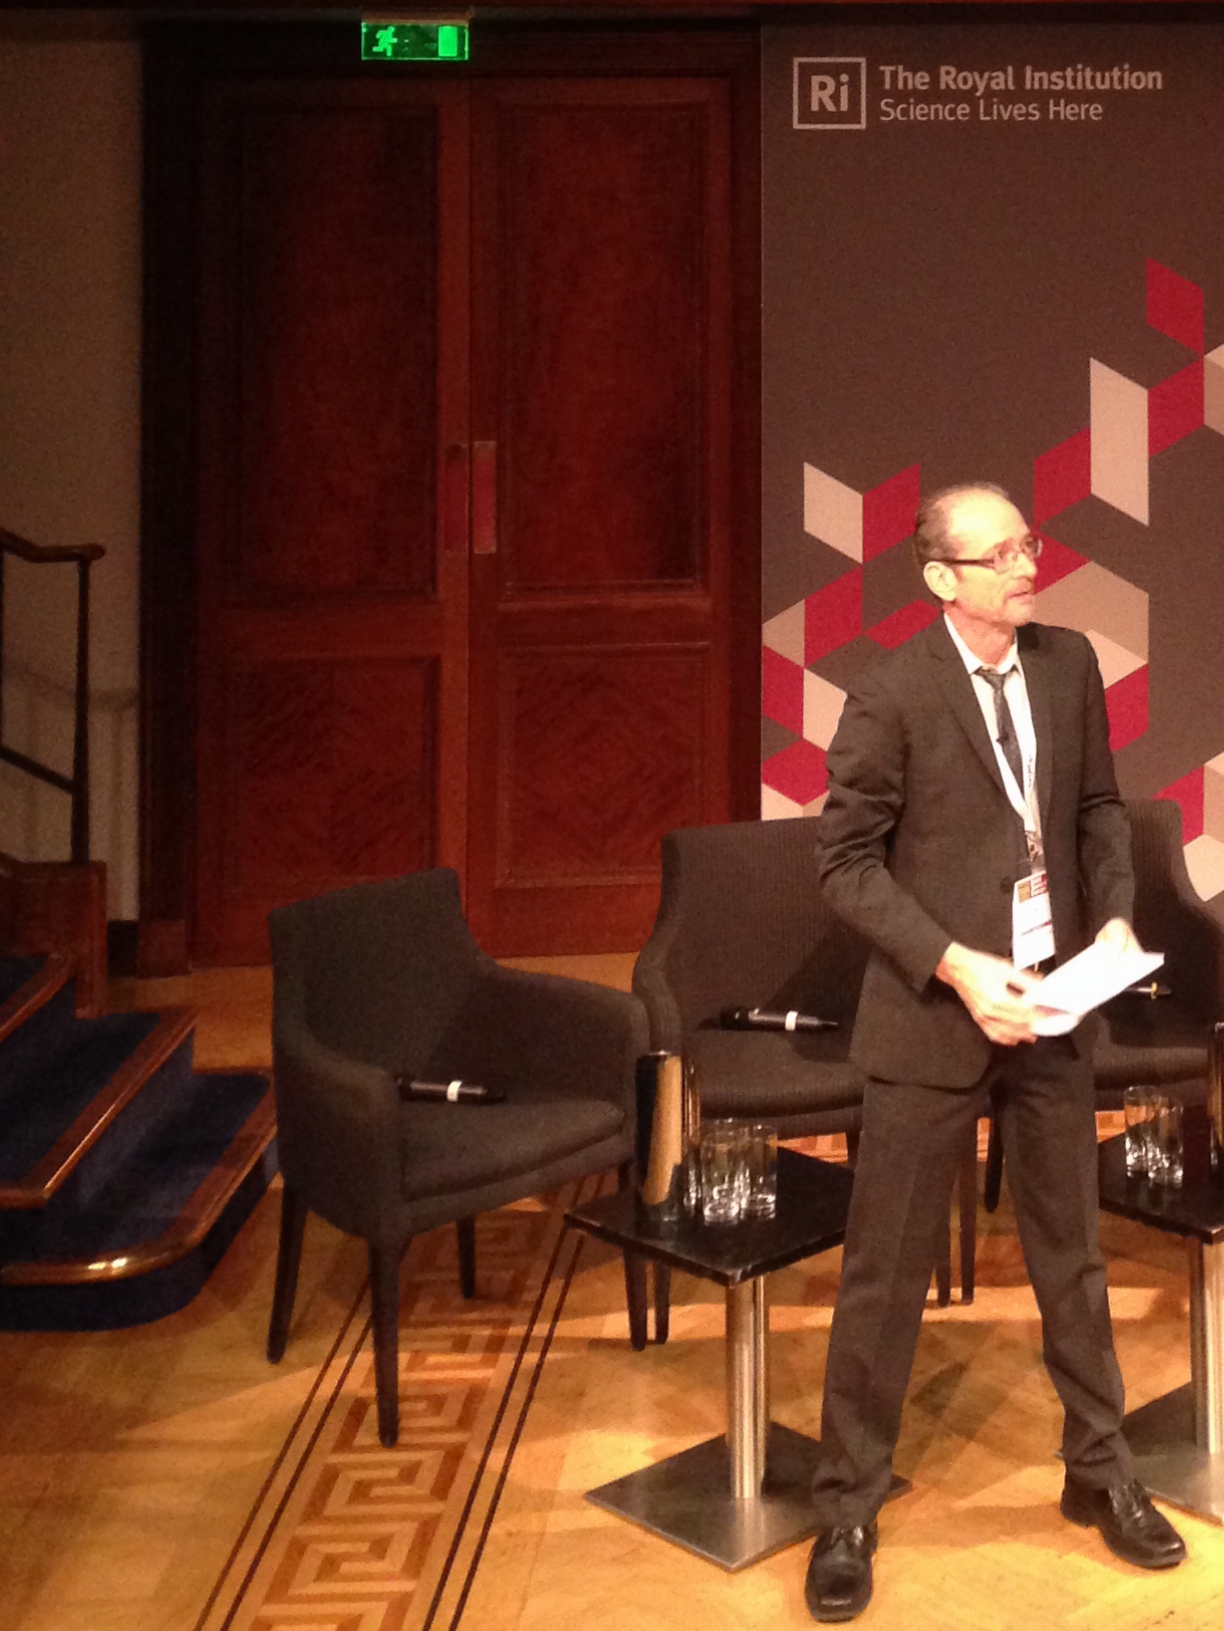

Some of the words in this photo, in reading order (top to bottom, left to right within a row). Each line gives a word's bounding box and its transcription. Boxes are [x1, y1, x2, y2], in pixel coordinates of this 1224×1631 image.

[810, 73, 850, 112] Ri
[880, 66, 930, 90] The
[940, 66, 1014, 96] Royal
[1025, 63, 1163, 90] Institution
[880, 98, 970, 121] Science
[979, 98, 1040, 121] Lives
[1049, 99, 1103, 121] Here
